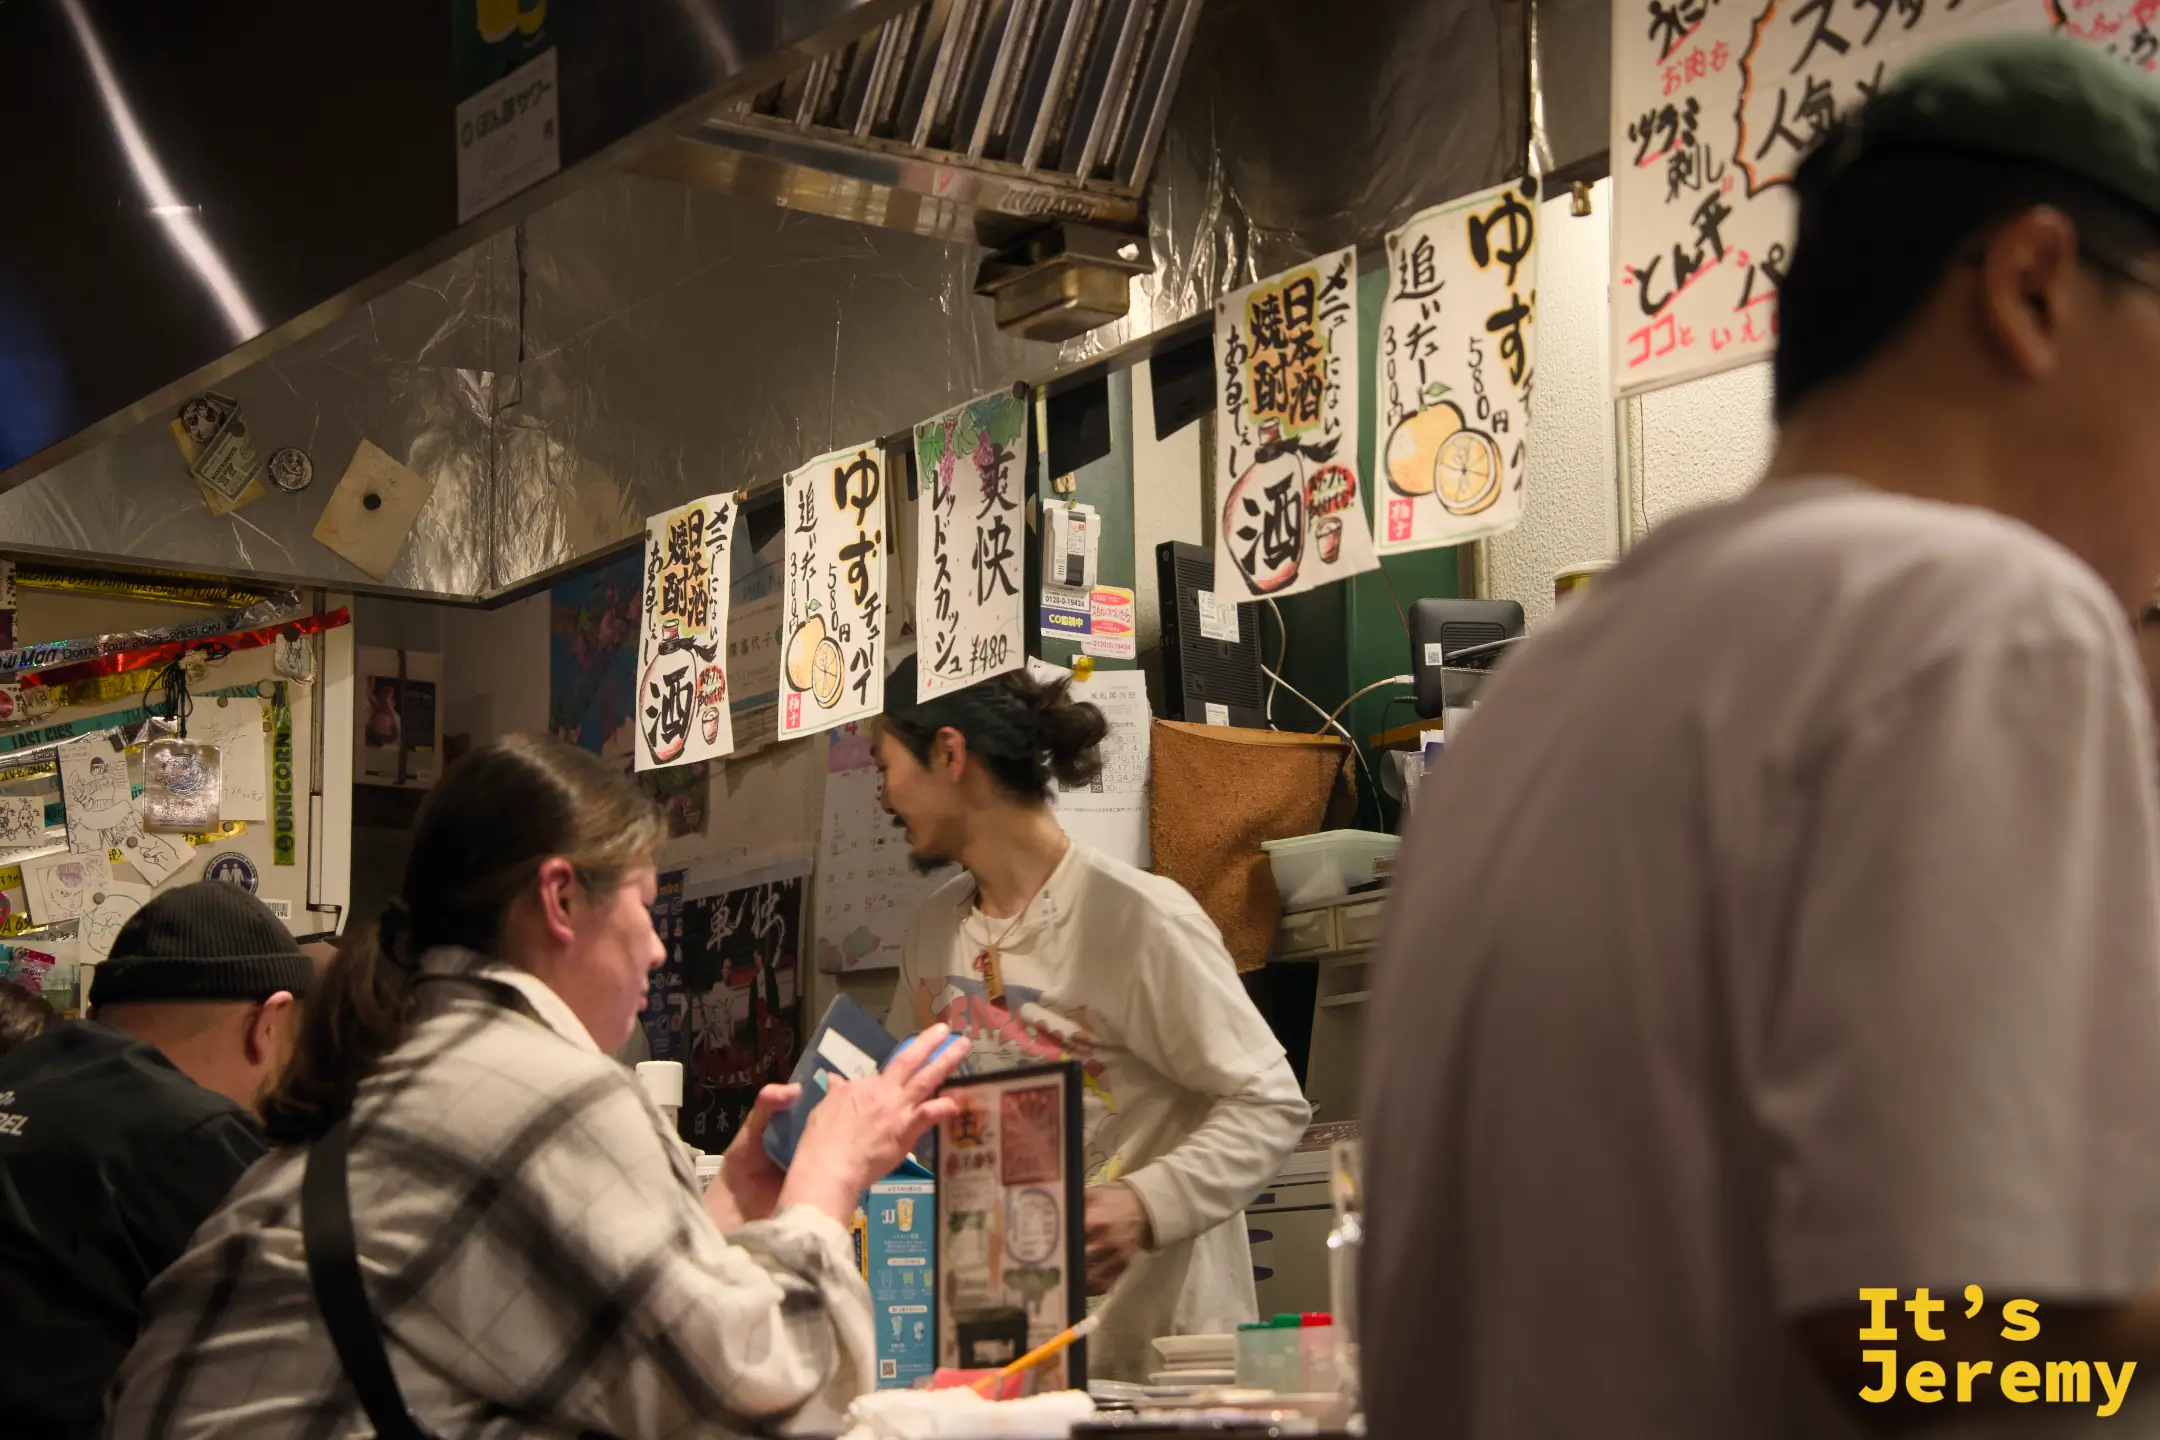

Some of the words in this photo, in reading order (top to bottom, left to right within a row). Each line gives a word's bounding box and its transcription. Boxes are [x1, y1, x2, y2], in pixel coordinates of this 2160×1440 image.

[1249, 291, 1288, 414] 焼酎
[1284, 276, 1324, 424] 日本酒
[1318, 263, 1351, 438] メニューにない
[1468, 338, 1510, 433] 580円
[660, 519, 690, 618] 焼酎
[685, 509, 708, 628] 日本酒
[705, 501, 729, 642] メニューにない
[794, 481, 818, 600] 追いチュー
[932, 469, 962, 673] レッドスカッシュ
[1237, 472, 1300, 576] 酒
[827, 562, 851, 644] 580円
[968, 633, 1012, 676] ¥480
[645, 665, 694, 747] 酒
[274, 731, 292, 832] UNICORN
